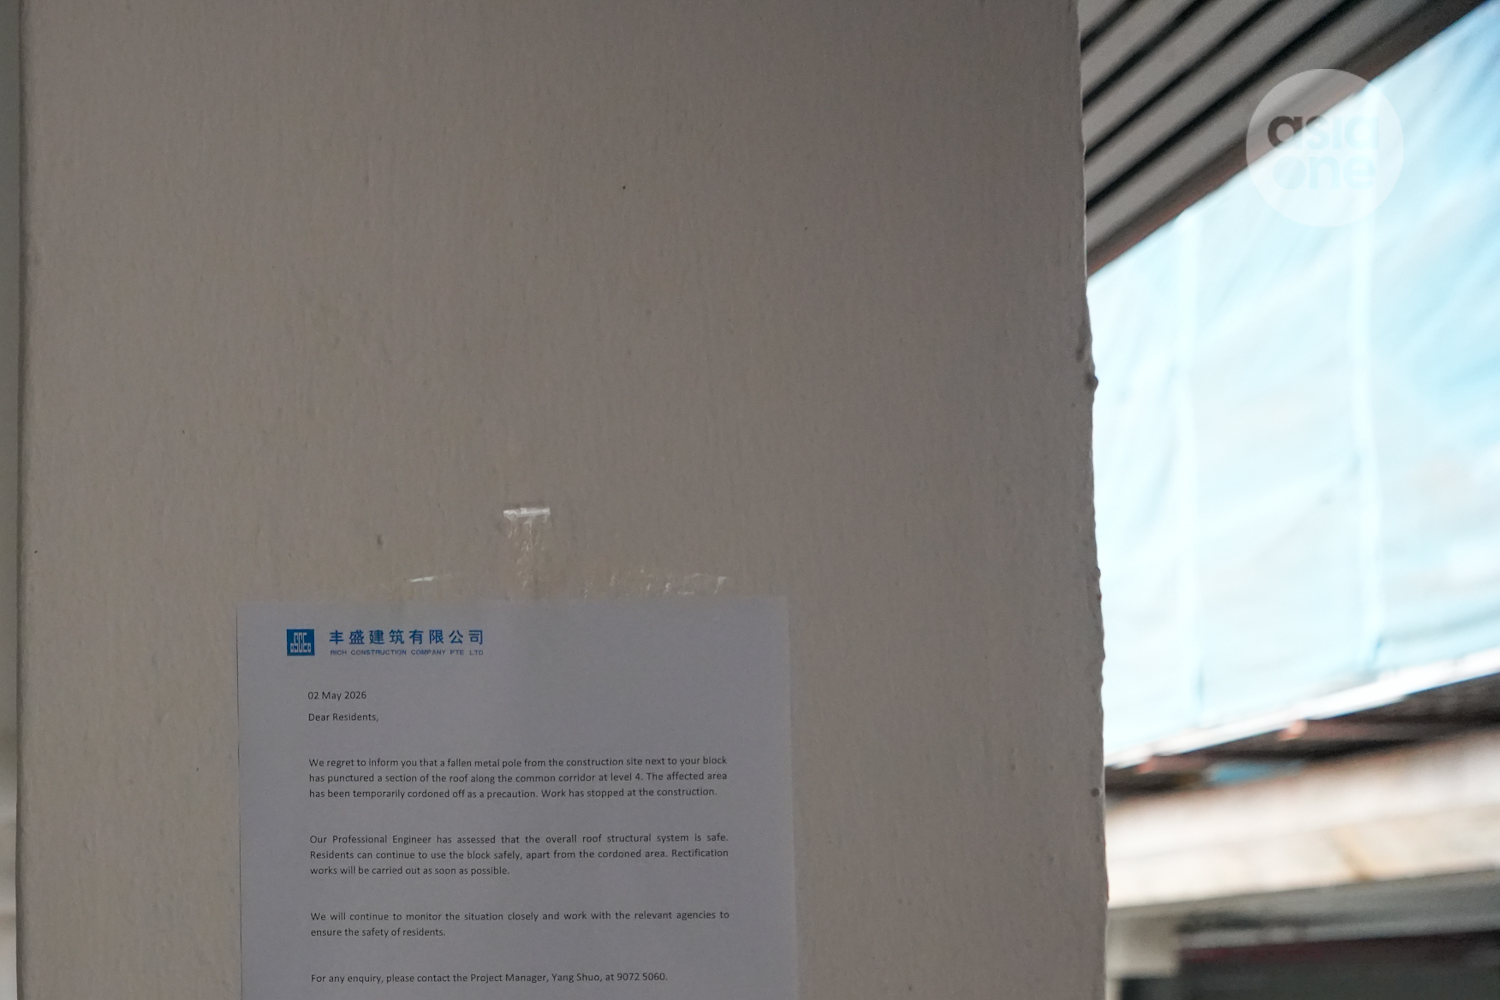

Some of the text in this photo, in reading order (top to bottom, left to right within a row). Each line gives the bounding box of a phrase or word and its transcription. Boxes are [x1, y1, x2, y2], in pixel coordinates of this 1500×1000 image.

[329, 629, 484, 645] 丰盛建筑有限公司
[307, 690, 368, 702] 02 May 2026
[308, 711, 379, 723] Dear Residents,
[308, 755, 727, 770] We regret to inform you that a fallen metal pole from the construction site next to your block
[308, 770, 728, 785] has punctured a section of the roof along the common corridor at level 4. The affected area
[308, 786, 718, 801] has been temporarily cordoned off as a precaution. Work has stopped at the construction.
[308, 831, 729, 846] Our Professional Engineer has assessed that the overall roof structural system is safe.
[309, 847, 729, 862] Residents can continue to use the block safely, apart from the cordoned area. Rectification
[310, 865, 510, 877] works will be carried out as soon as possible.
[310, 909, 730, 923] We will continue to monitor the situation closely and work with the relevant agencies to
[310, 926, 446, 939] ensure the safety of residents.
[310, 971, 668, 985] For any enquiry, please contact the Project Manager, Yang Shuo, at 9072 5060.
